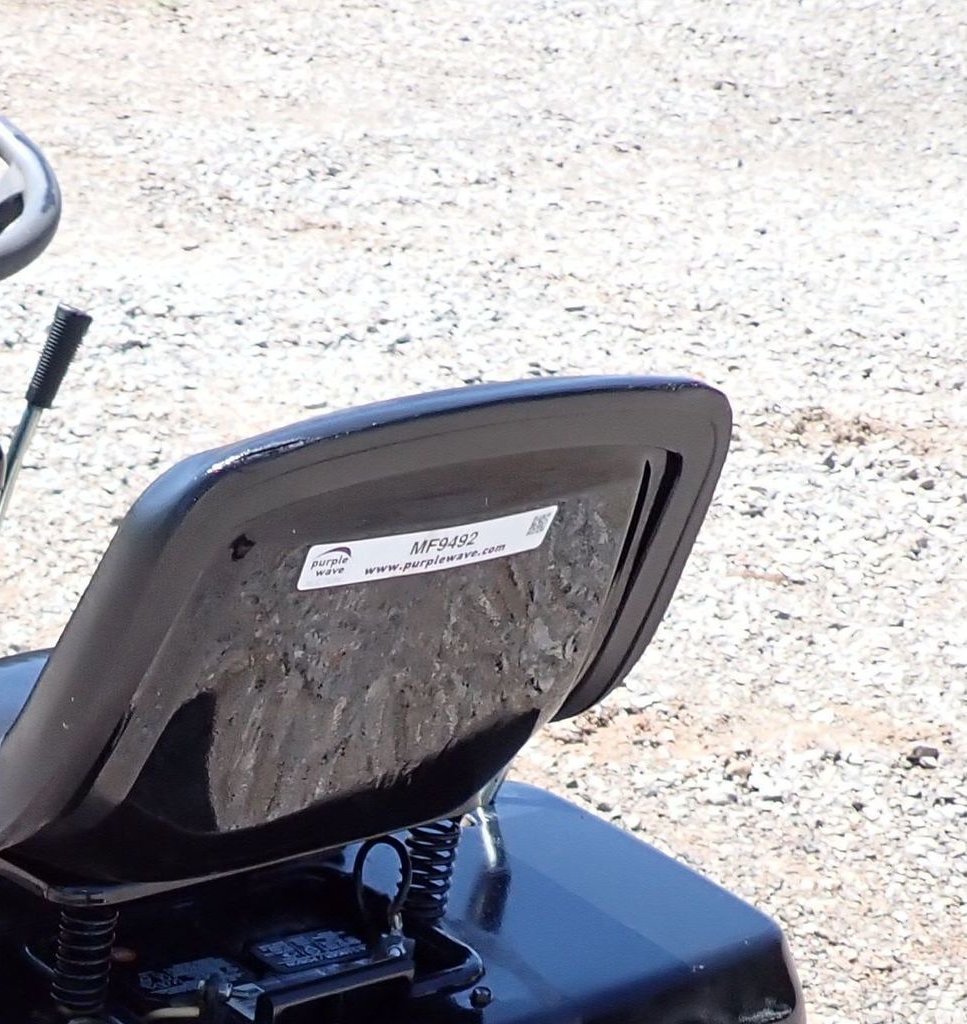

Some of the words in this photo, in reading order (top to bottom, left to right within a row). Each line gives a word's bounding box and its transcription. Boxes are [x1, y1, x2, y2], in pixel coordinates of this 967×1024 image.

[410, 531, 479, 556] MF9492
[310, 557, 349, 570] purple
[364, 543, 506, 575] www.purplewave.com
[315, 566, 345, 577] wave
